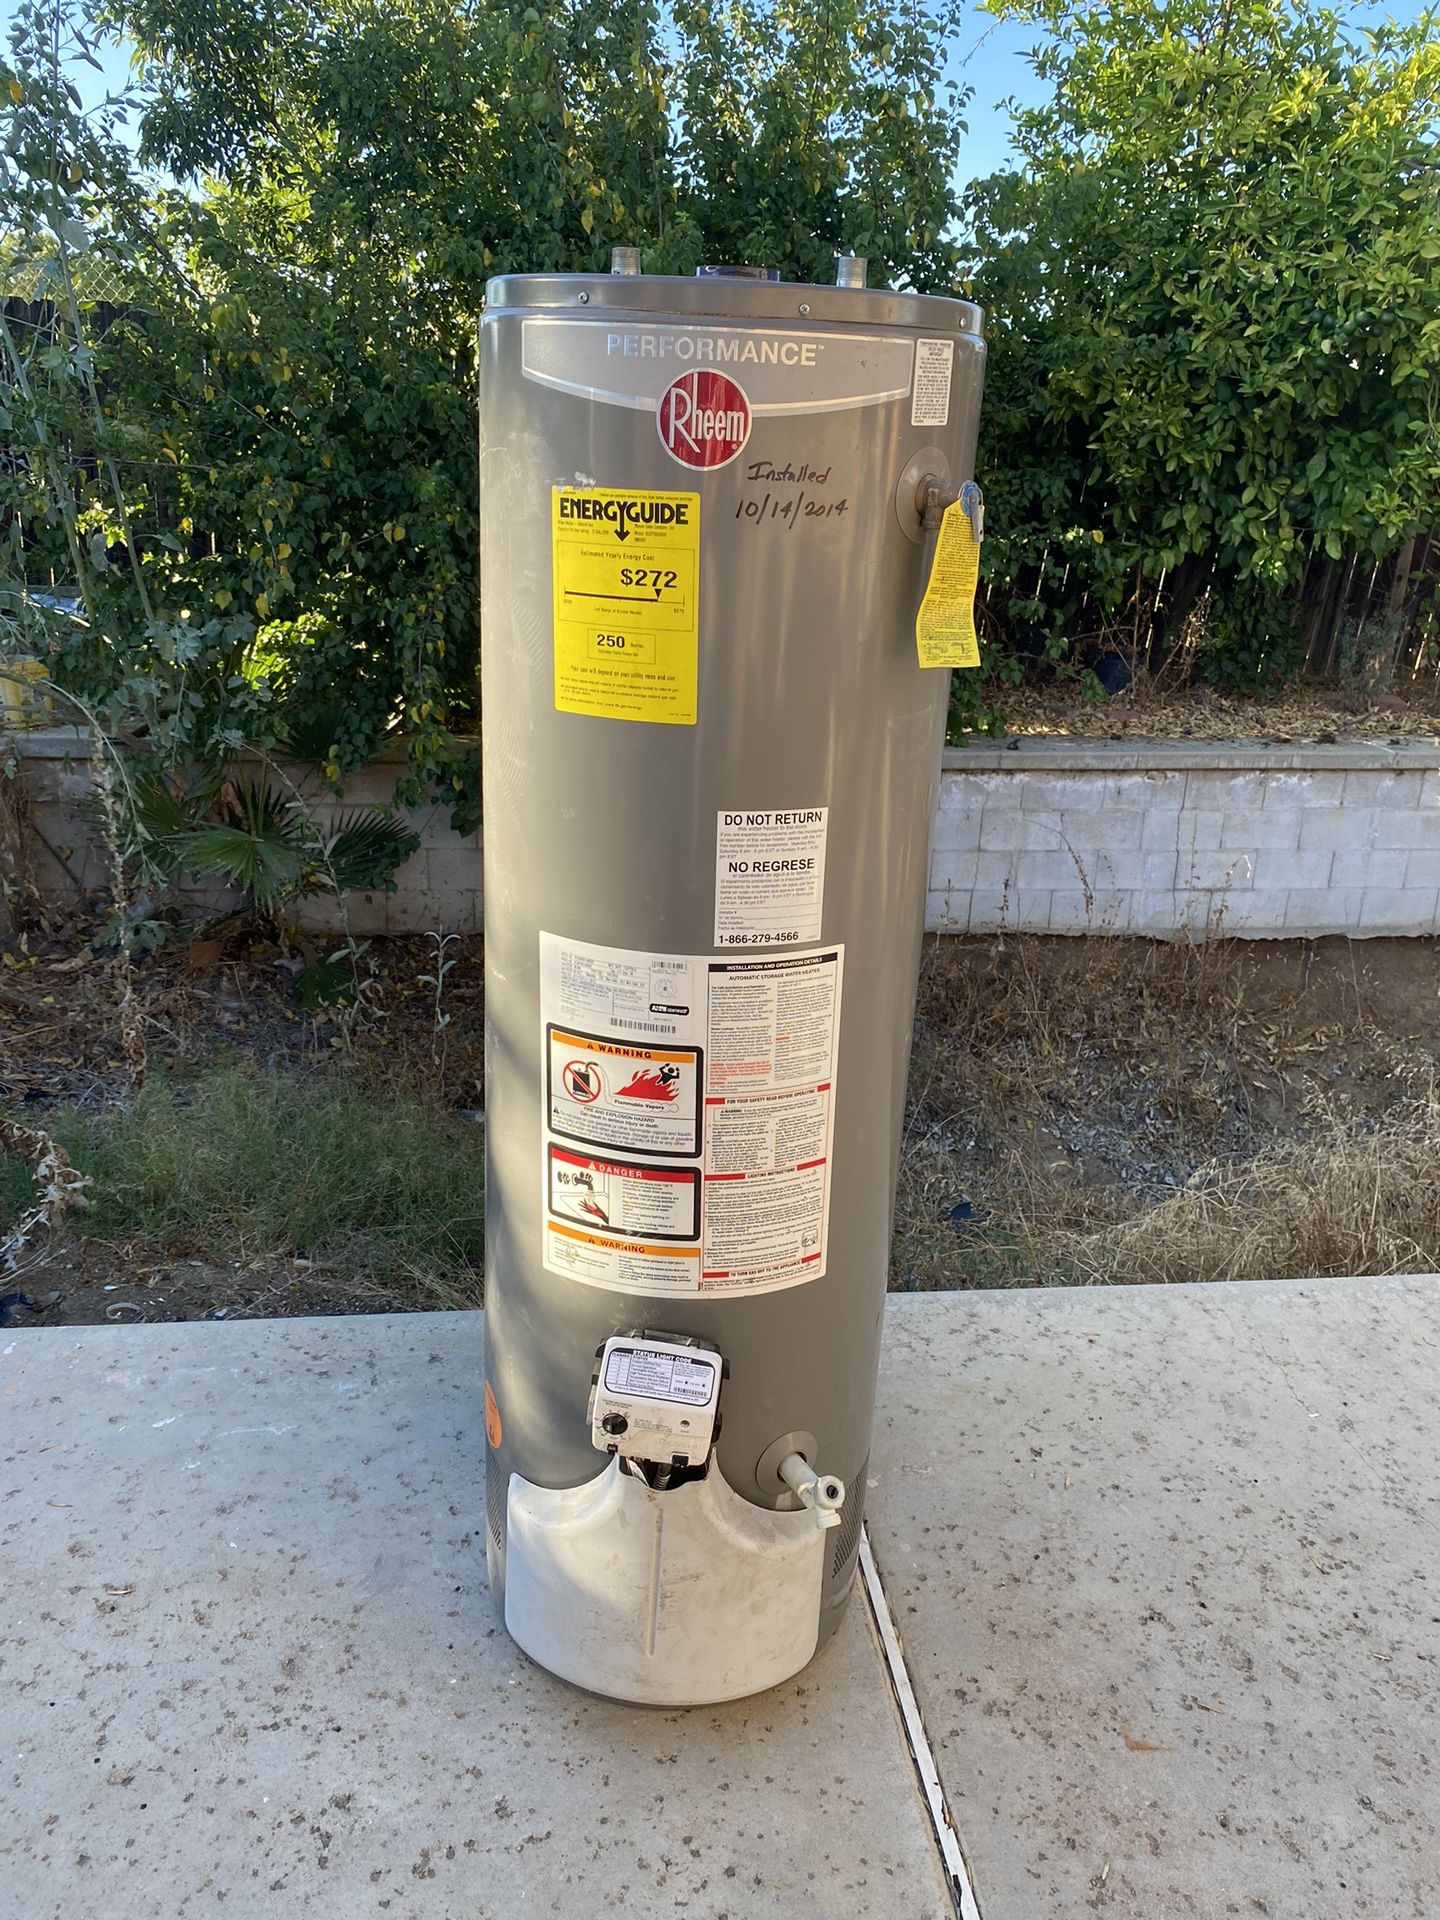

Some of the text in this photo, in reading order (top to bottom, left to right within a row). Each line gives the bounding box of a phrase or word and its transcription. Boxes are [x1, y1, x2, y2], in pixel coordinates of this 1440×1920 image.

[607, 333, 818, 367] PERFORMANCE
[668, 371, 746, 454] Rheem
[747, 461, 832, 485] Installed
[559, 497, 689, 528] ENERGYGUIDE
[736, 491, 849, 529] 10/14/2014
[620, 568, 678, 588] $272
[596, 634, 626, 648] 250
[725, 811, 822, 826] DO NOT RETURN
[729, 858, 815, 873] NO REGRESE
[719, 931, 799, 944] 1-866-279-4566
[776, 960, 803, 968] OPERATION
[803, 957, 823, 965] DETAILS
[598, 1044, 652, 1059] WARNING
[614, 1099, 664, 1111] Flammable Vapors
[599, 1165, 643, 1179] DANGER
[600, 1239, 646, 1255] WARNING
[633, 1350, 692, 1364] STATUS LIGHT CODE
